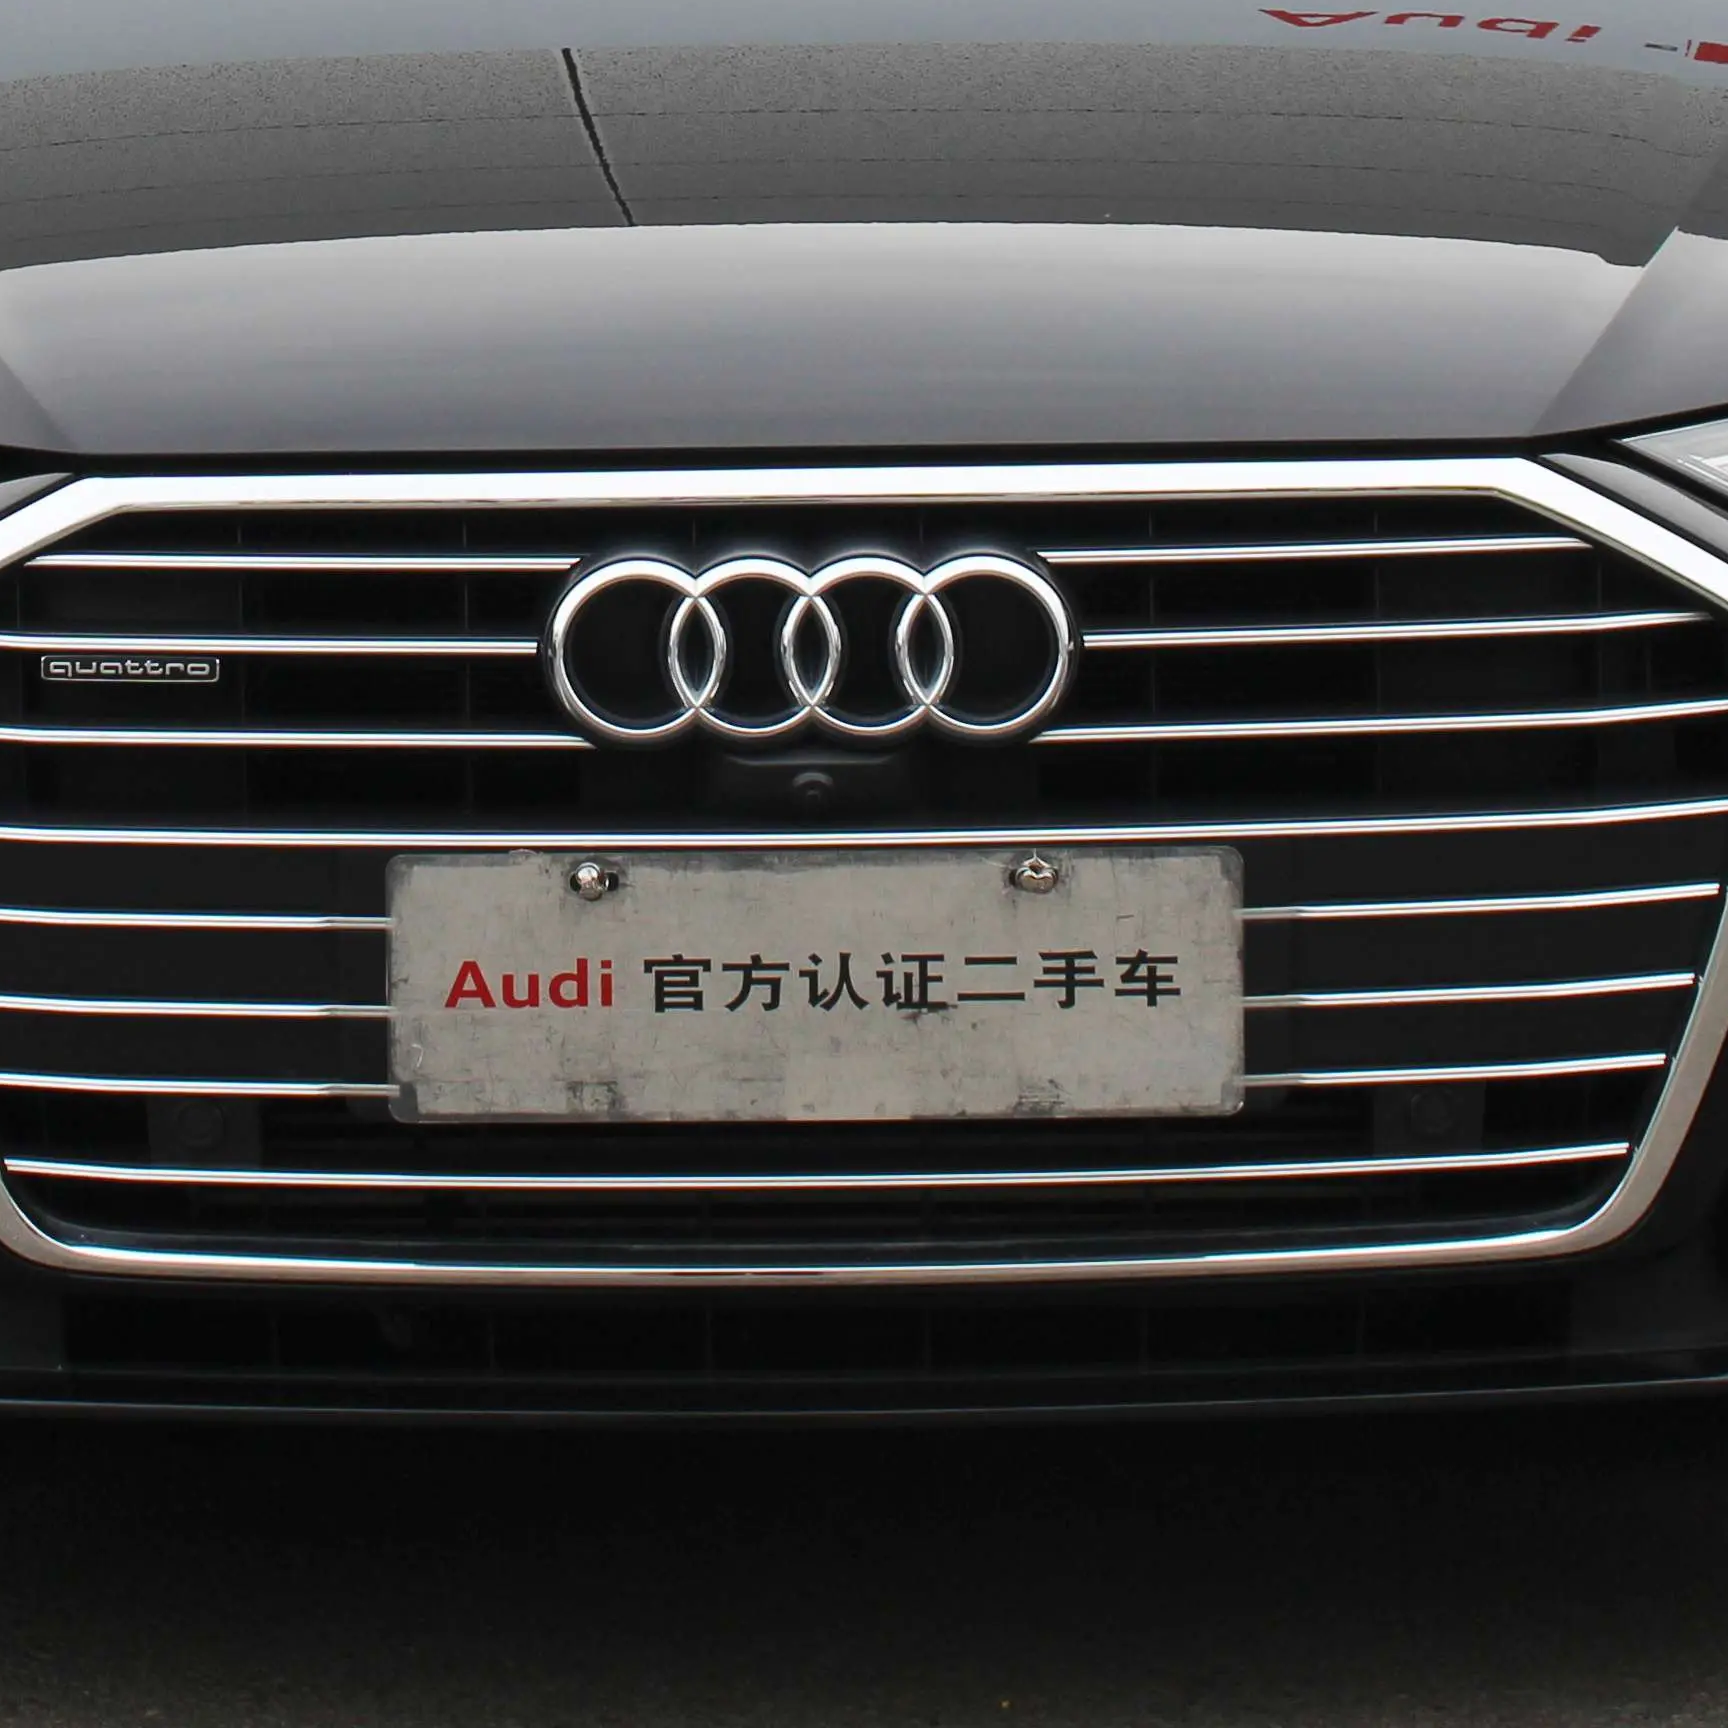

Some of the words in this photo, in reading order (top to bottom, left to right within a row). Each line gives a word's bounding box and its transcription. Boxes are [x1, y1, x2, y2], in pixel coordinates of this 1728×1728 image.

[48, 658, 211, 678] quattro
[444, 956, 614, 1010] Audi
[641, 949, 1184, 1014] 官方认证二手车
